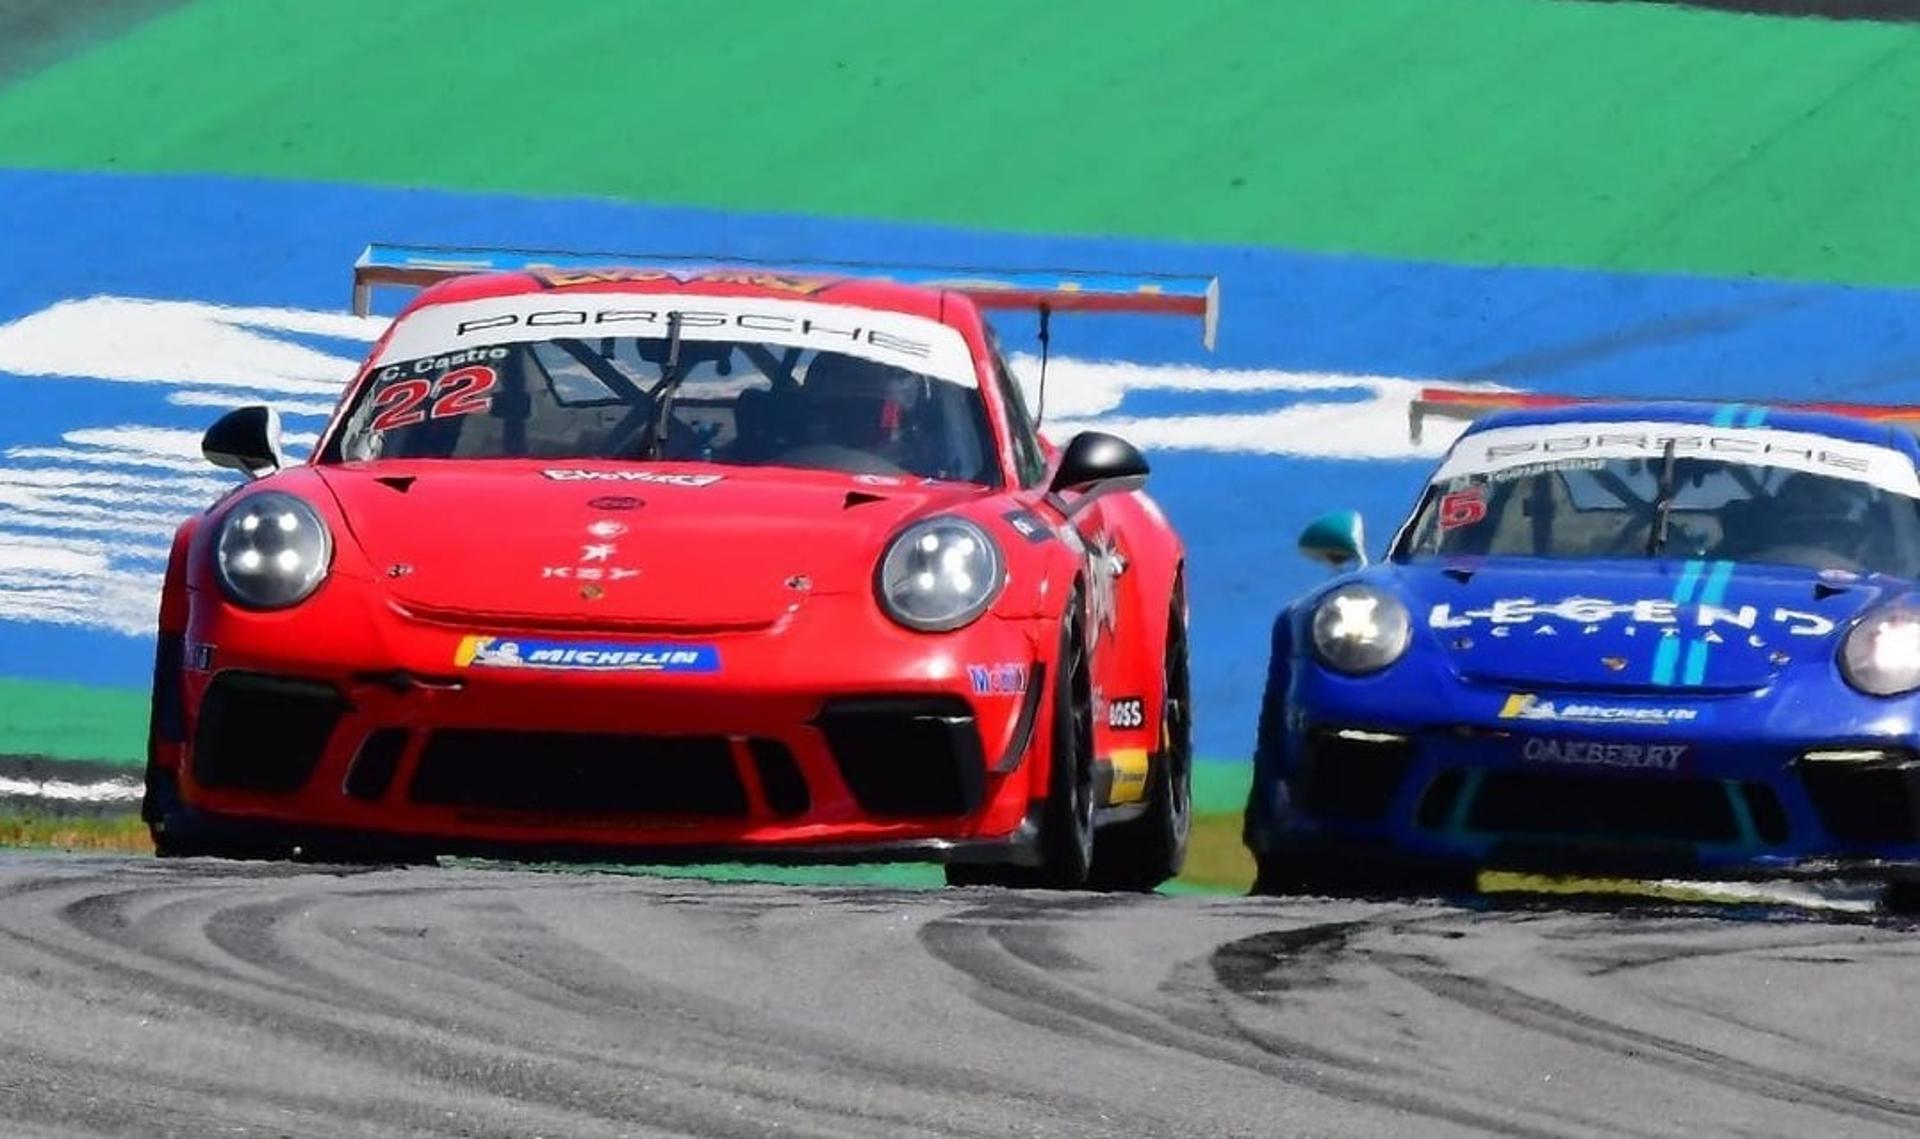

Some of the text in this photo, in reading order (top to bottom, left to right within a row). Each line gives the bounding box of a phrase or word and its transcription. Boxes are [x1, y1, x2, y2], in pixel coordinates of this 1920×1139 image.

[457, 310, 931, 359] PORSCHE
[414, 348, 509, 373] Castro
[371, 364, 497, 432] 22
[1439, 486, 1488, 531] 5
[1428, 600, 1835, 636] LEGEND
[529, 648, 700, 665] MICHELIN
[1561, 704, 1698, 720] MICHELIN
[1523, 737, 1689, 770] OAKBERRY
